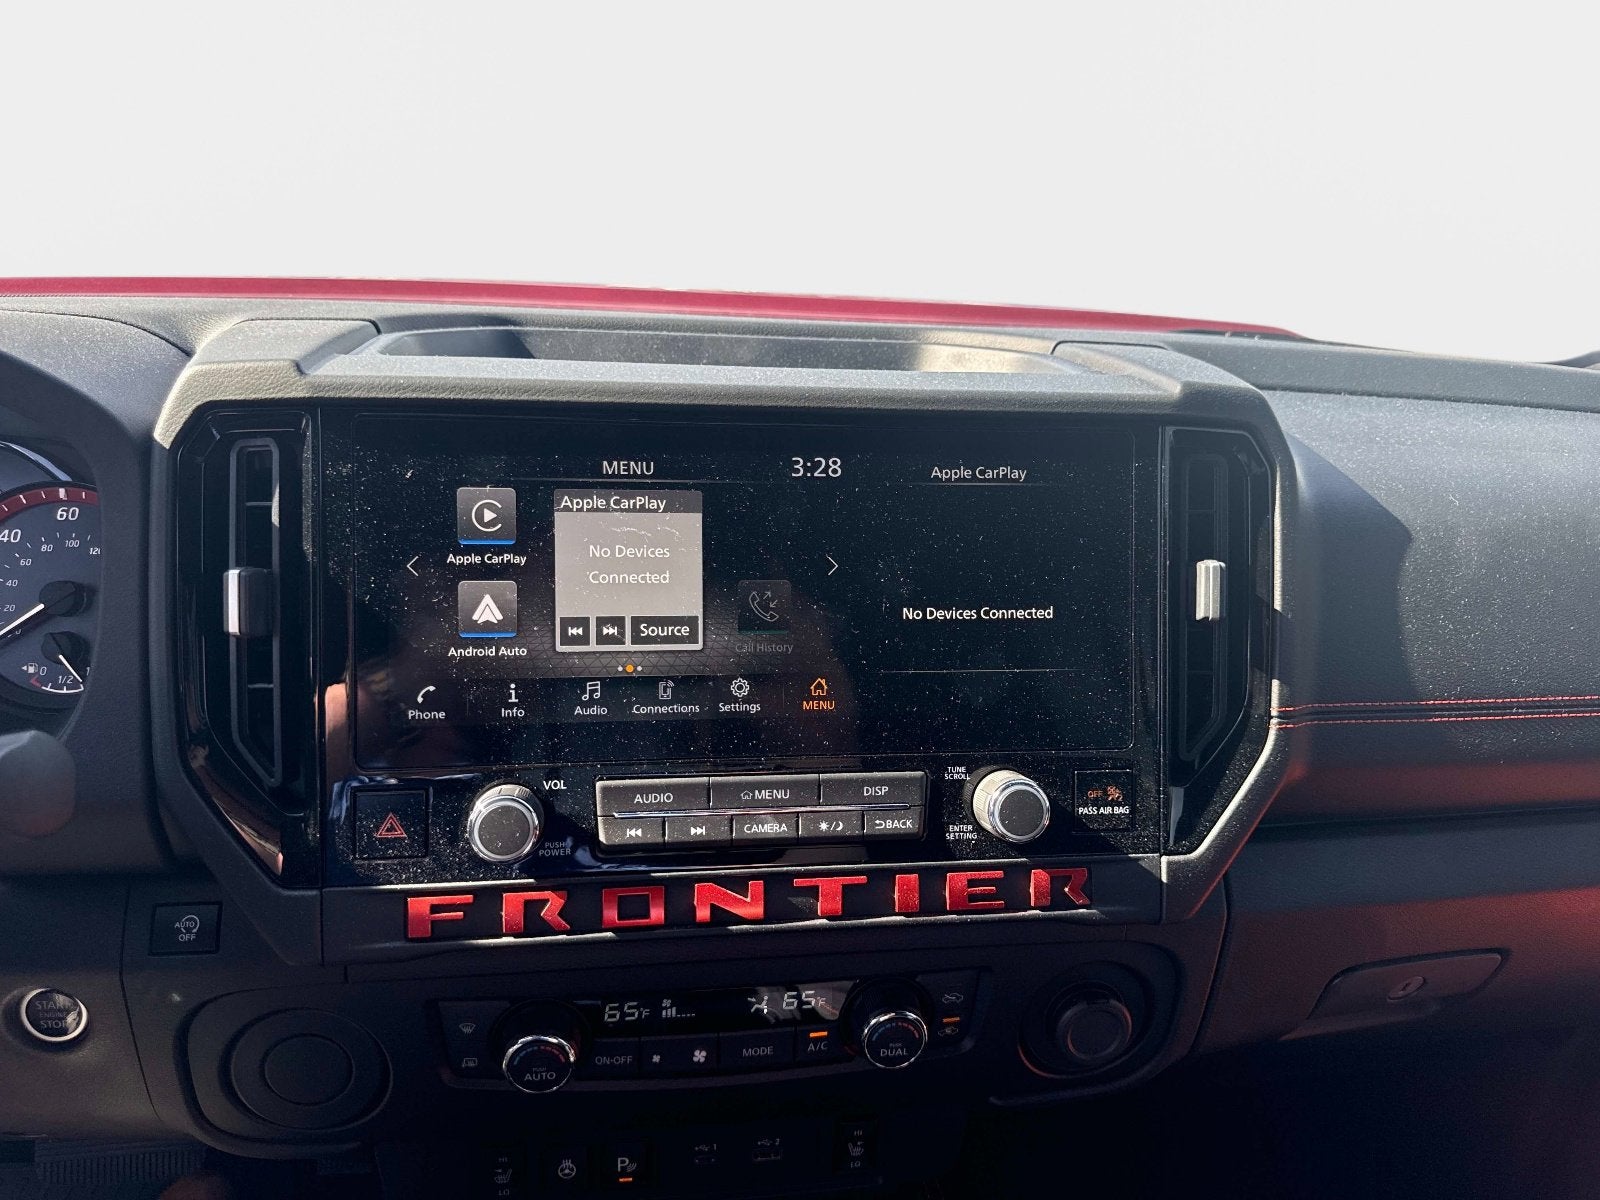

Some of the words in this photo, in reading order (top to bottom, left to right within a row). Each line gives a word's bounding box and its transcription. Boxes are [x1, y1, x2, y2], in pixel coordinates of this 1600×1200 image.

[602, 461, 654, 475] MENU
[791, 457, 842, 477] 3:28
[931, 466, 972, 480] Apple
[975, 466, 1027, 481] CarPlay
[560, 496, 606, 511] Apple
[610, 496, 666, 512] CarPlay
[57, 507, 79, 520] 60
[0, 529, 21, 543] 40
[65, 540, 80, 548] 100
[589, 545, 611, 558] No
[615, 545, 670, 558] Devices
[20, 558, 32, 566] 60
[447, 554, 482, 566] Apple
[484, 554, 527, 566] CarPlay
[589, 571, 670, 584] Connected
[6, 579, 18, 587] 40
[4, 604, 15, 612] 20
[902, 607, 923, 620] No
[926, 607, 977, 620] Devices
[980, 606, 1054, 620] Connected
[640, 623, 690, 636] Source
[448, 647, 496, 657] Android
[499, 647, 528, 657] Auto
[735, 643, 754, 652] Call
[757, 643, 794, 655] History
[39, 667, 47, 676] 0
[58, 676, 73, 684] 1/2
[633, 704, 700, 715] Connections
[719, 702, 761, 714] Settings
[802, 700, 835, 711] MENU
[408, 710, 446, 720] Phone
[501, 708, 525, 718] Info
[574, 706, 608, 716] Audio
[947, 766, 967, 774] TUNE
[944, 773, 971, 781] SCROLL
[543, 780, 567, 790] VOL
[755, 789, 790, 800] MENU
[863, 786, 889, 797] DISP
[1087, 790, 1103, 798] OFF
[633, 793, 674, 804] AUDIO
[1078, 806, 1098, 815] PASS
[1099, 806, 1113, 815] AIR
[1113, 805, 1130, 814] BAG
[743, 823, 788, 834] CAMERA
[886, 819, 913, 829] BACK
[945, 832, 977, 840] SETTING
[544, 841, 566, 849] PUSH
[538, 848, 572, 857] POWER
[407, 867, 1092, 940] FRONTIER
[178, 933, 197, 942] OFF
[742, 1046, 774, 1057] MODE
[807, 1041, 829, 1052] A/C
[880, 1048, 909, 1057] DUAL
[524, 1071, 556, 1081] AUTO
